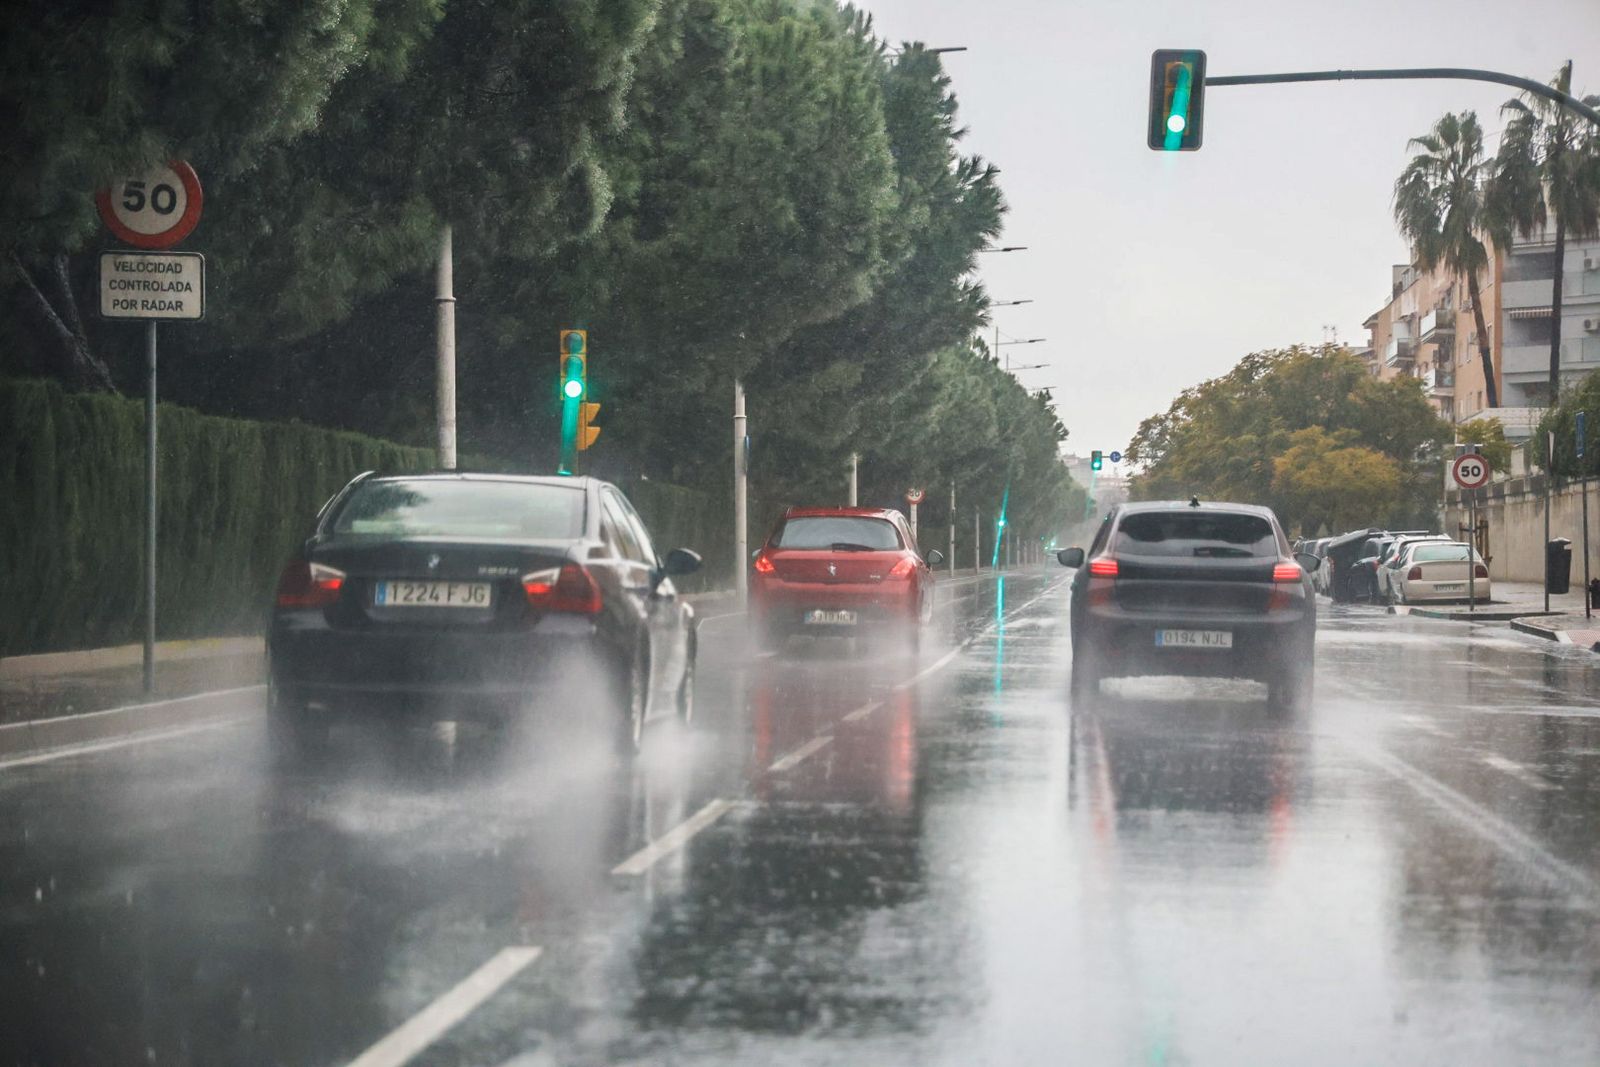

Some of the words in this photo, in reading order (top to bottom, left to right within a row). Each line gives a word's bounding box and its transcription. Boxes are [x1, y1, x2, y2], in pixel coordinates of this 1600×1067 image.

[122, 181, 177, 215] 50
[113, 261, 183, 274] VELOCIDAD
[109, 279, 193, 292] CONTROLADA
[112, 299, 138, 311] POR
[141, 300, 184, 312] RADAR
[1461, 465, 1481, 477] 50
[392, 583, 439, 602] 1224
[447, 583, 485, 603] FJG
[1164, 631, 1196, 644] 0194
[1202, 632, 1228, 645] NJL
